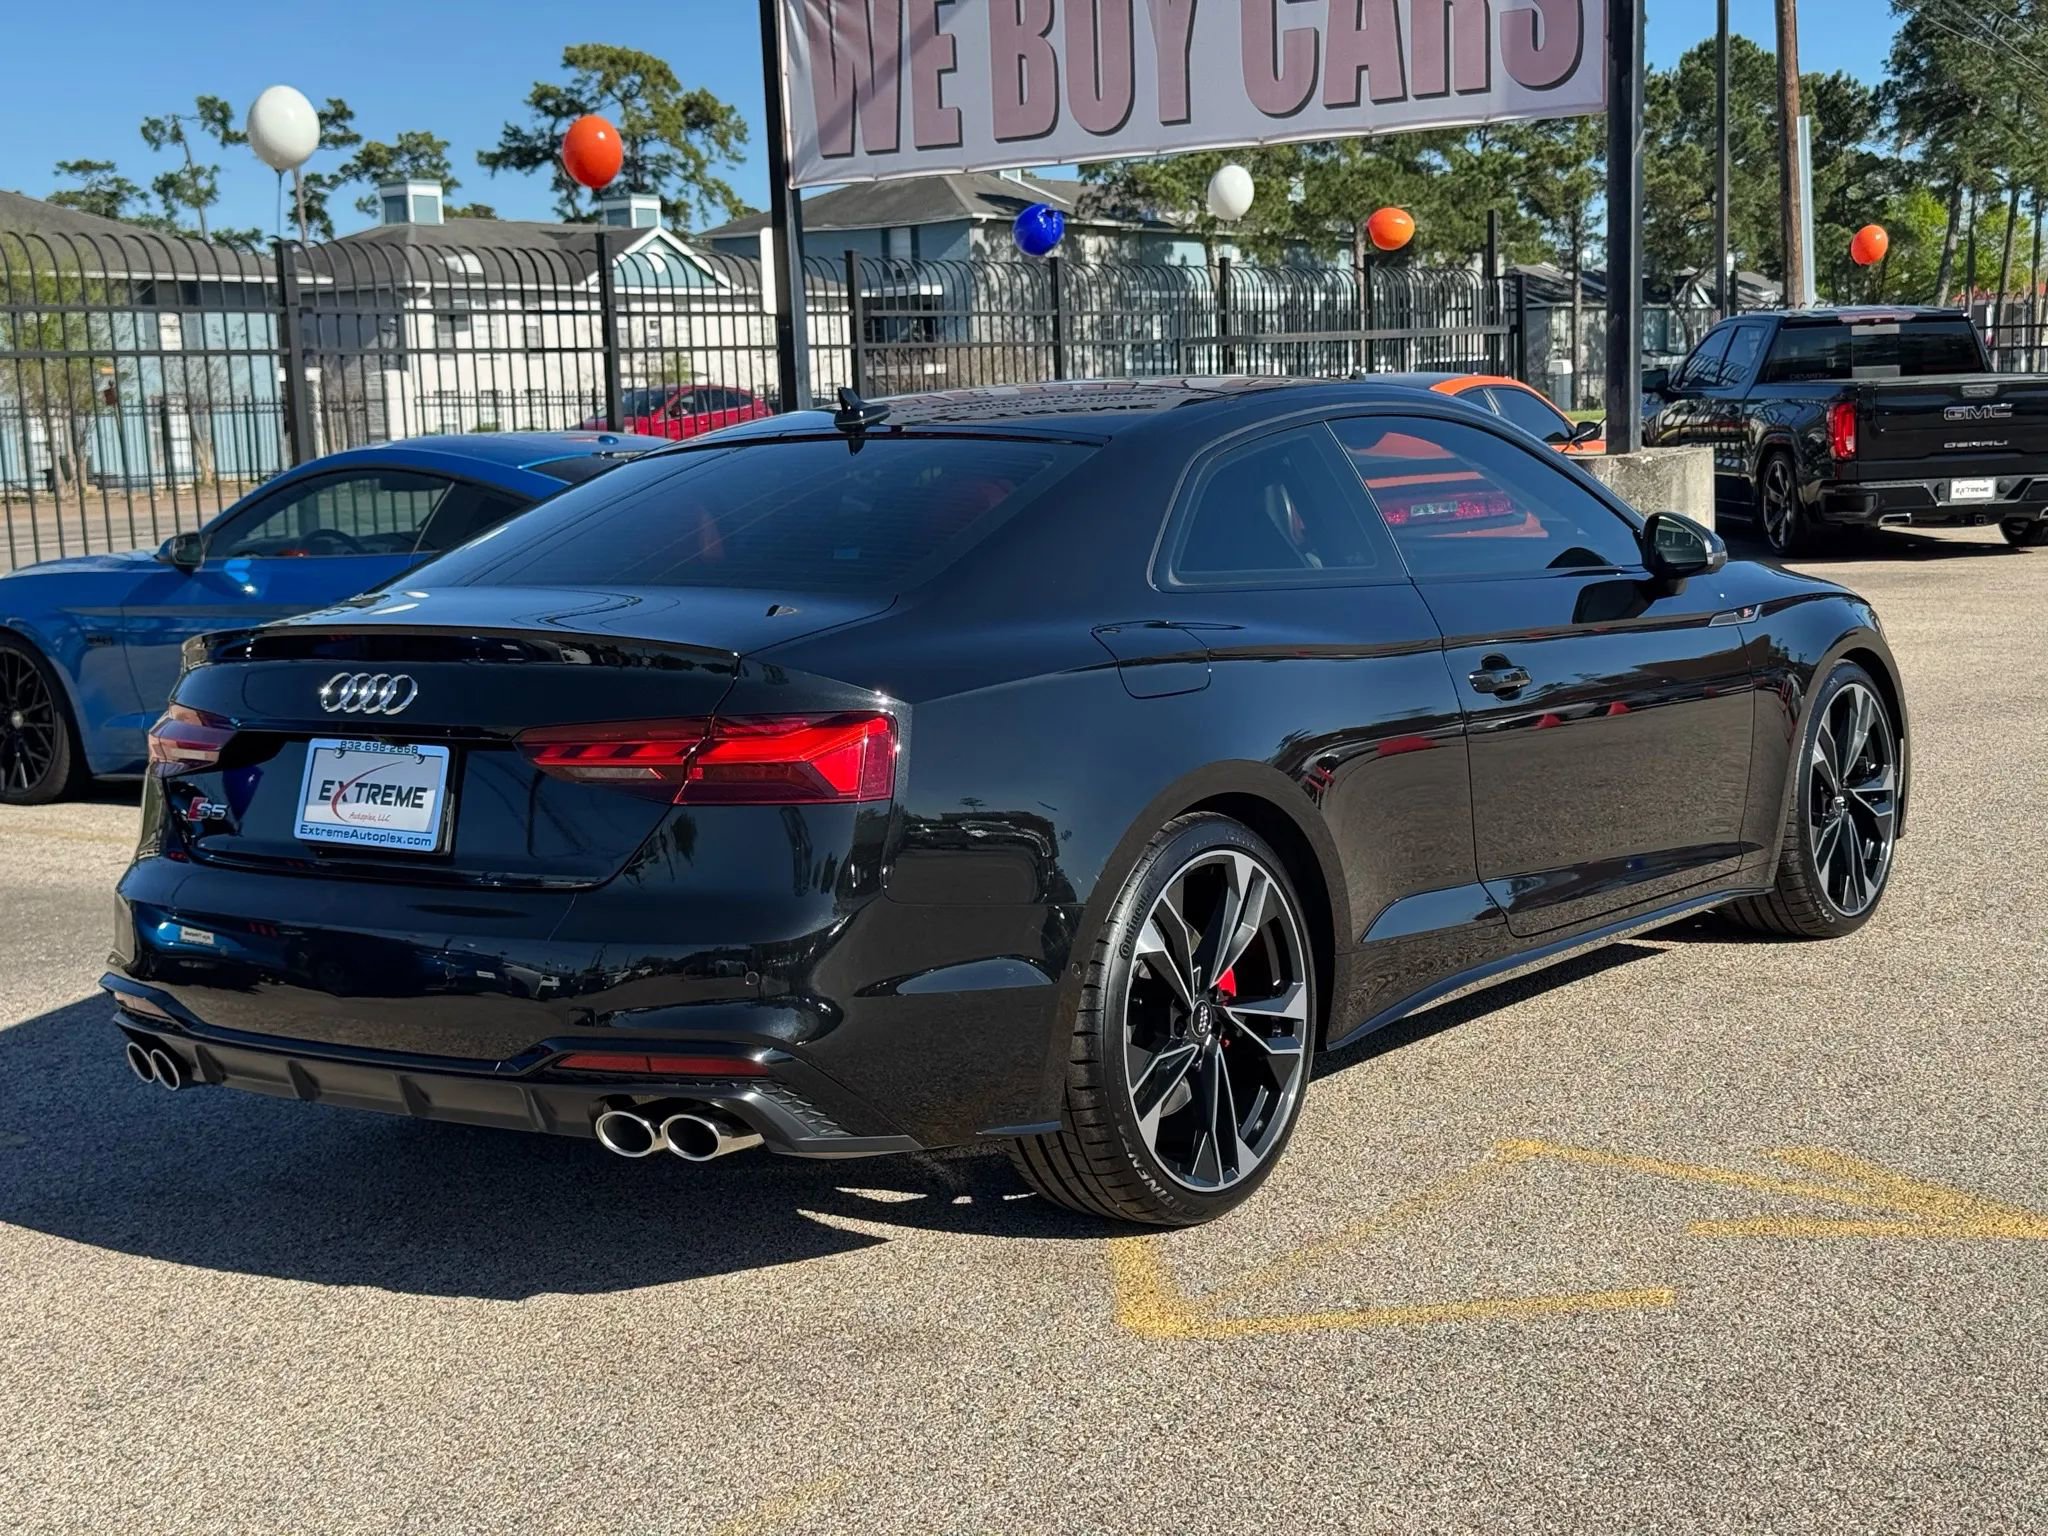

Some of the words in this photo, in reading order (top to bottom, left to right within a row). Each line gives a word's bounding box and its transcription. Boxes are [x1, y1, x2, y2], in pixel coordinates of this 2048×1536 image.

[803, 0, 962, 158] WE
[989, 0, 1199, 144] BUY
[1944, 403, 2013, 420] GMC
[1944, 440, 2008, 448] DENALI
[318, 779, 428, 809] EXTREME
[195, 802, 228, 820] S5
[300, 824, 432, 847] ExtremeAutoplex.com
